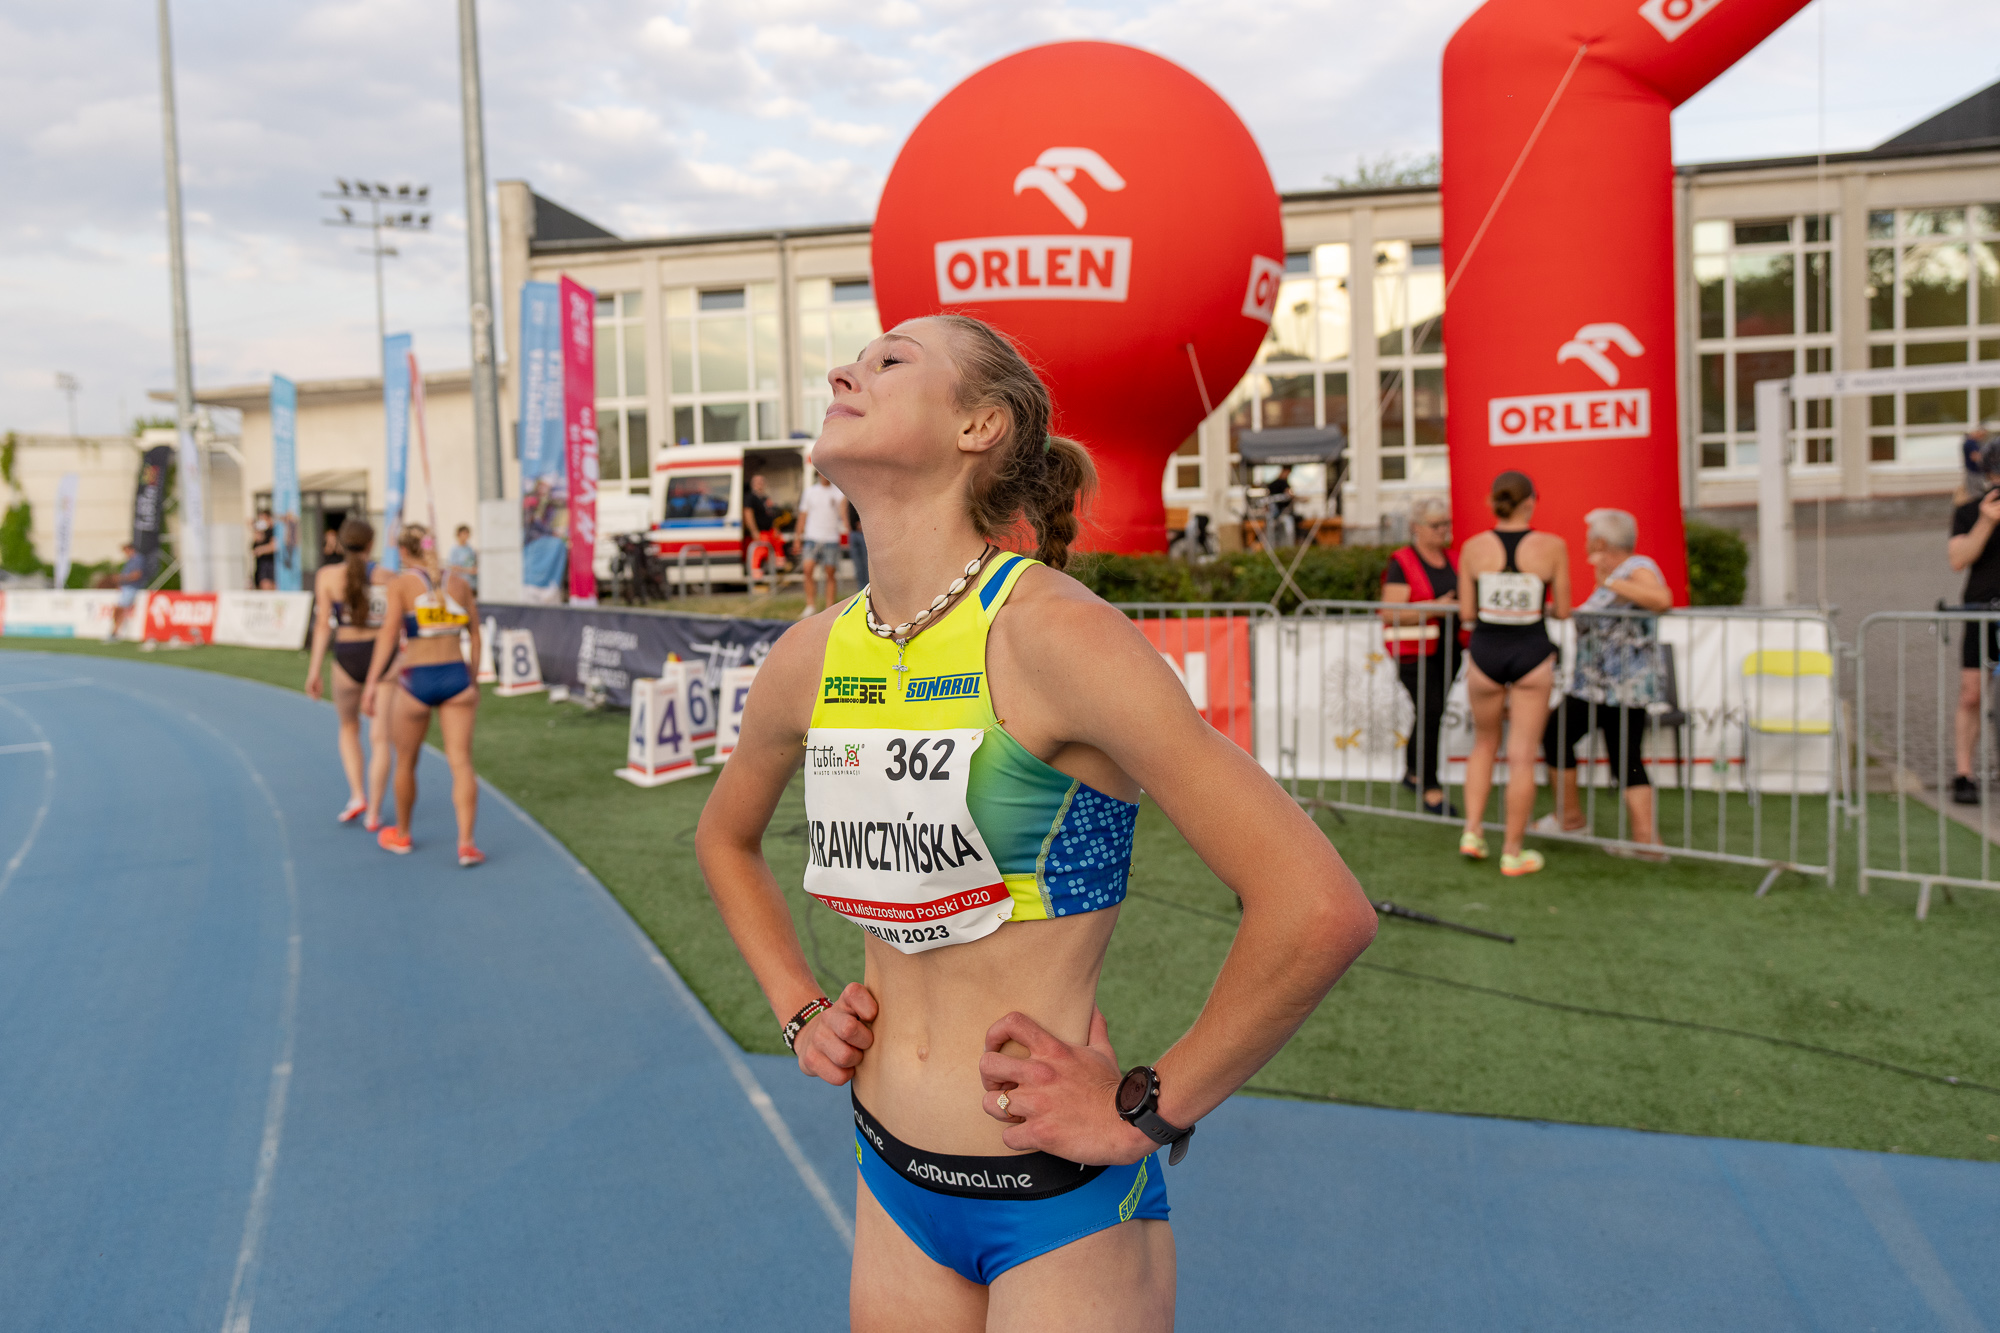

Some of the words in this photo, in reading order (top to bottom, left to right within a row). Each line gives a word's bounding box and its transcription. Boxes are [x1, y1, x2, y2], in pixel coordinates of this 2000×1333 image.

[947, 247, 1115, 290] ORLEN
[1501, 399, 1638, 434] ORLEN
[1489, 589, 1532, 608] 458
[512, 644, 531, 677] 8
[688, 679, 707, 725] 6
[905, 675, 981, 701] SONAROL
[657, 699, 683, 754] 4
[885, 737, 955, 781] 362
[808, 811, 983, 874] KRAWCZYŃSKA
[831, 900, 854, 914] PZLA
[854, 903, 914, 920] Mistrzostwa
[916, 898, 960, 918] Polski
[961, 890, 991, 907] U20
[855, 921, 900, 943] BLIN
[902, 924, 950, 944] 2023
